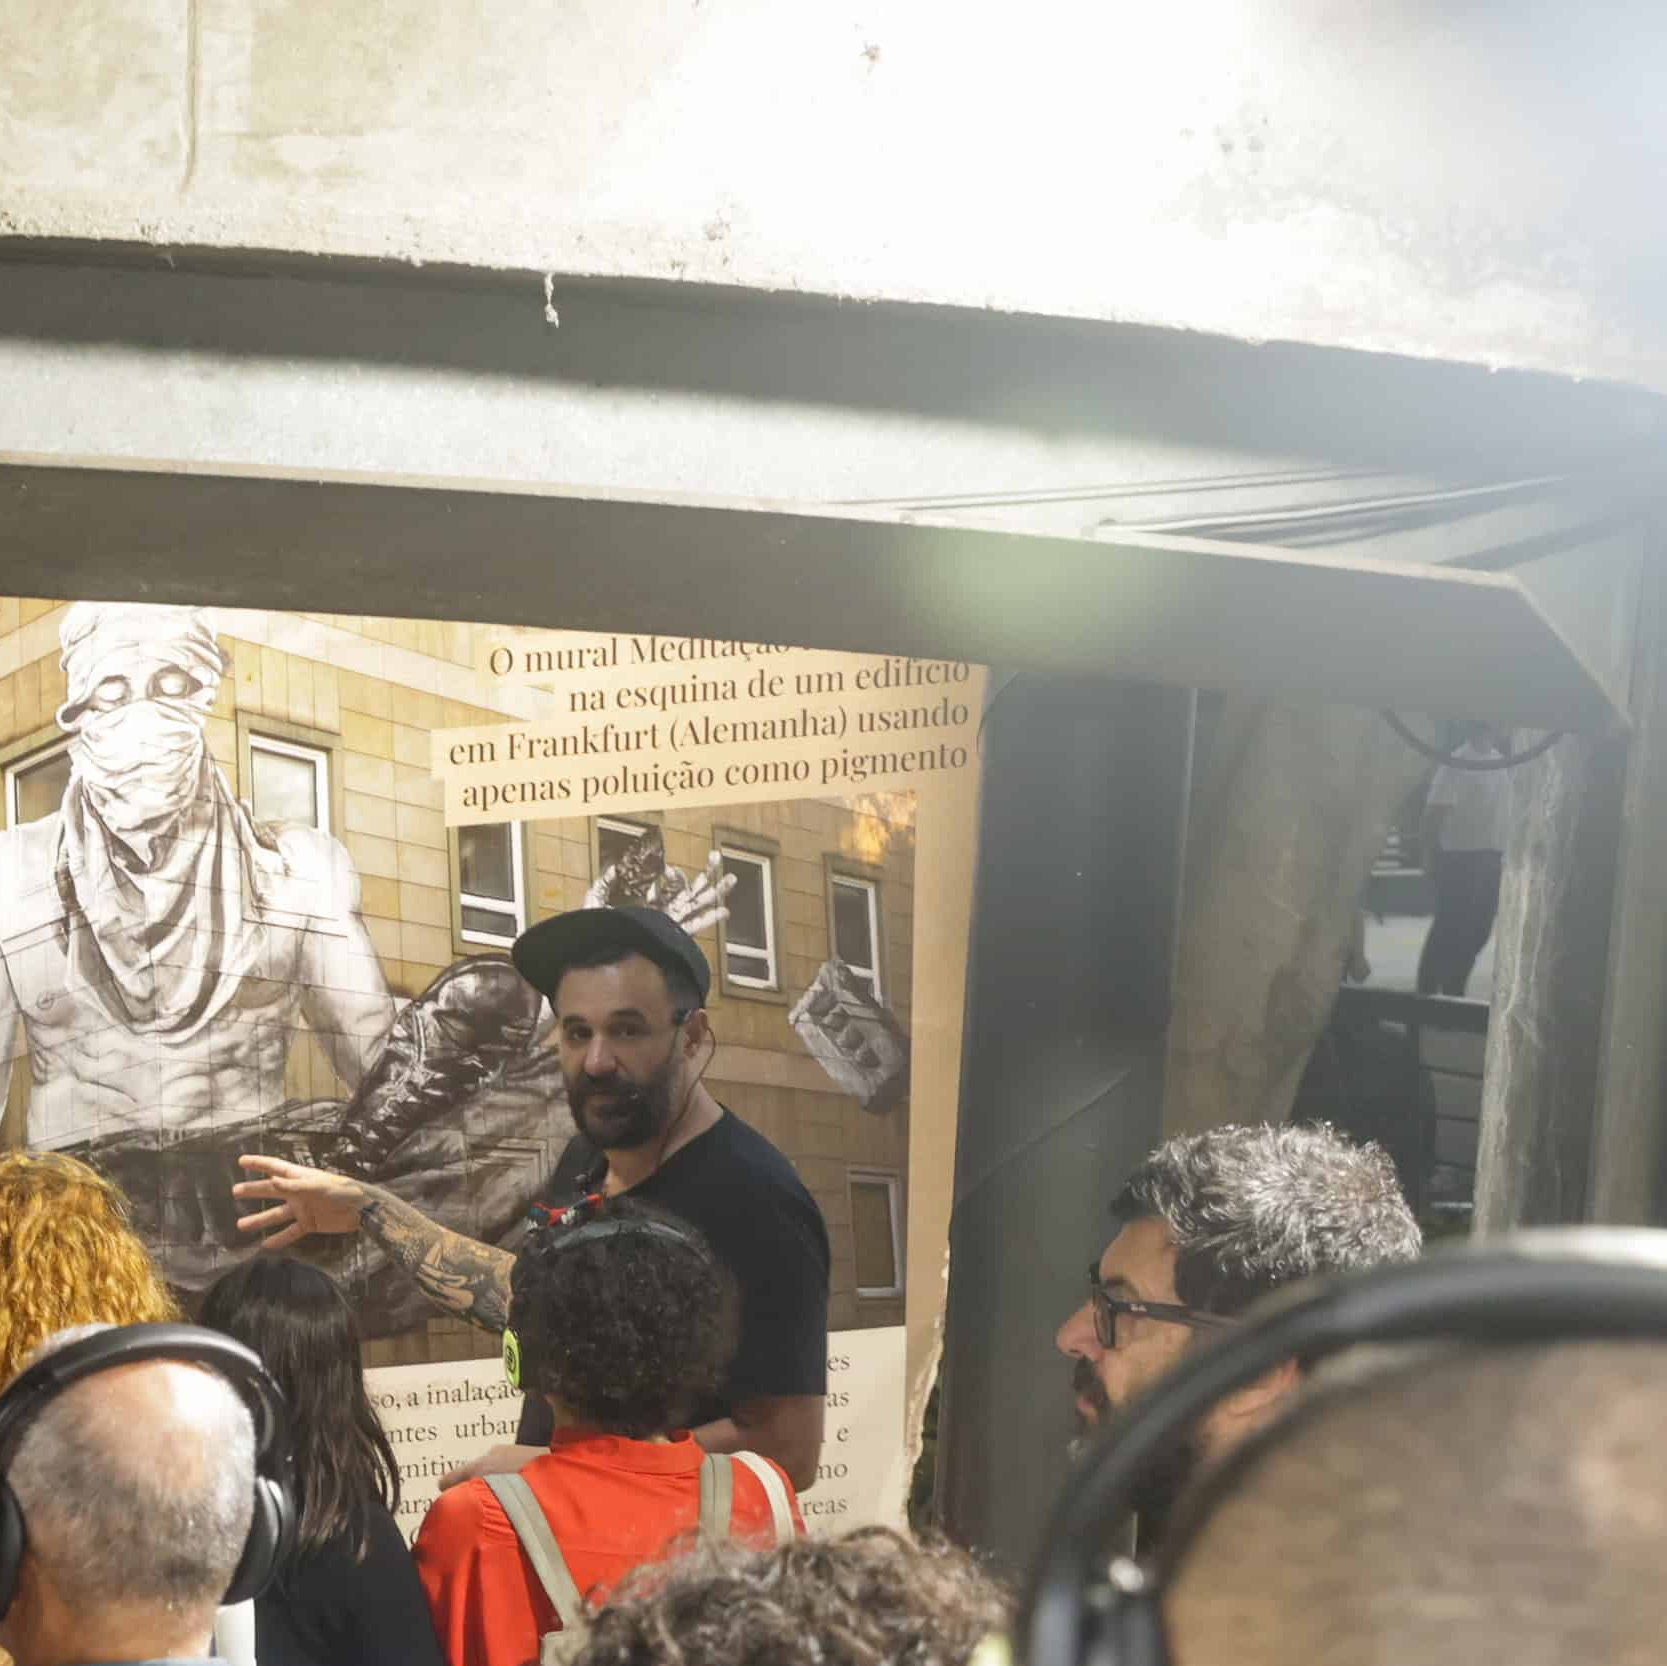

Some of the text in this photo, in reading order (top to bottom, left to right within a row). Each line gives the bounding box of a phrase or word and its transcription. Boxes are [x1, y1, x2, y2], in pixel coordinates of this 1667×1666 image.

[489, 647, 514, 676] O
[525, 637, 619, 673] mural
[569, 688, 605, 713] na
[616, 674, 738, 712] esquina
[747, 669, 785, 699] de
[794, 670, 845, 696] um
[449, 696, 969, 766] em Frankfurt (Alemanha) usando
[462, 743, 969, 811] apenas poluição como pigmento
[407, 1391, 419, 1407] a
